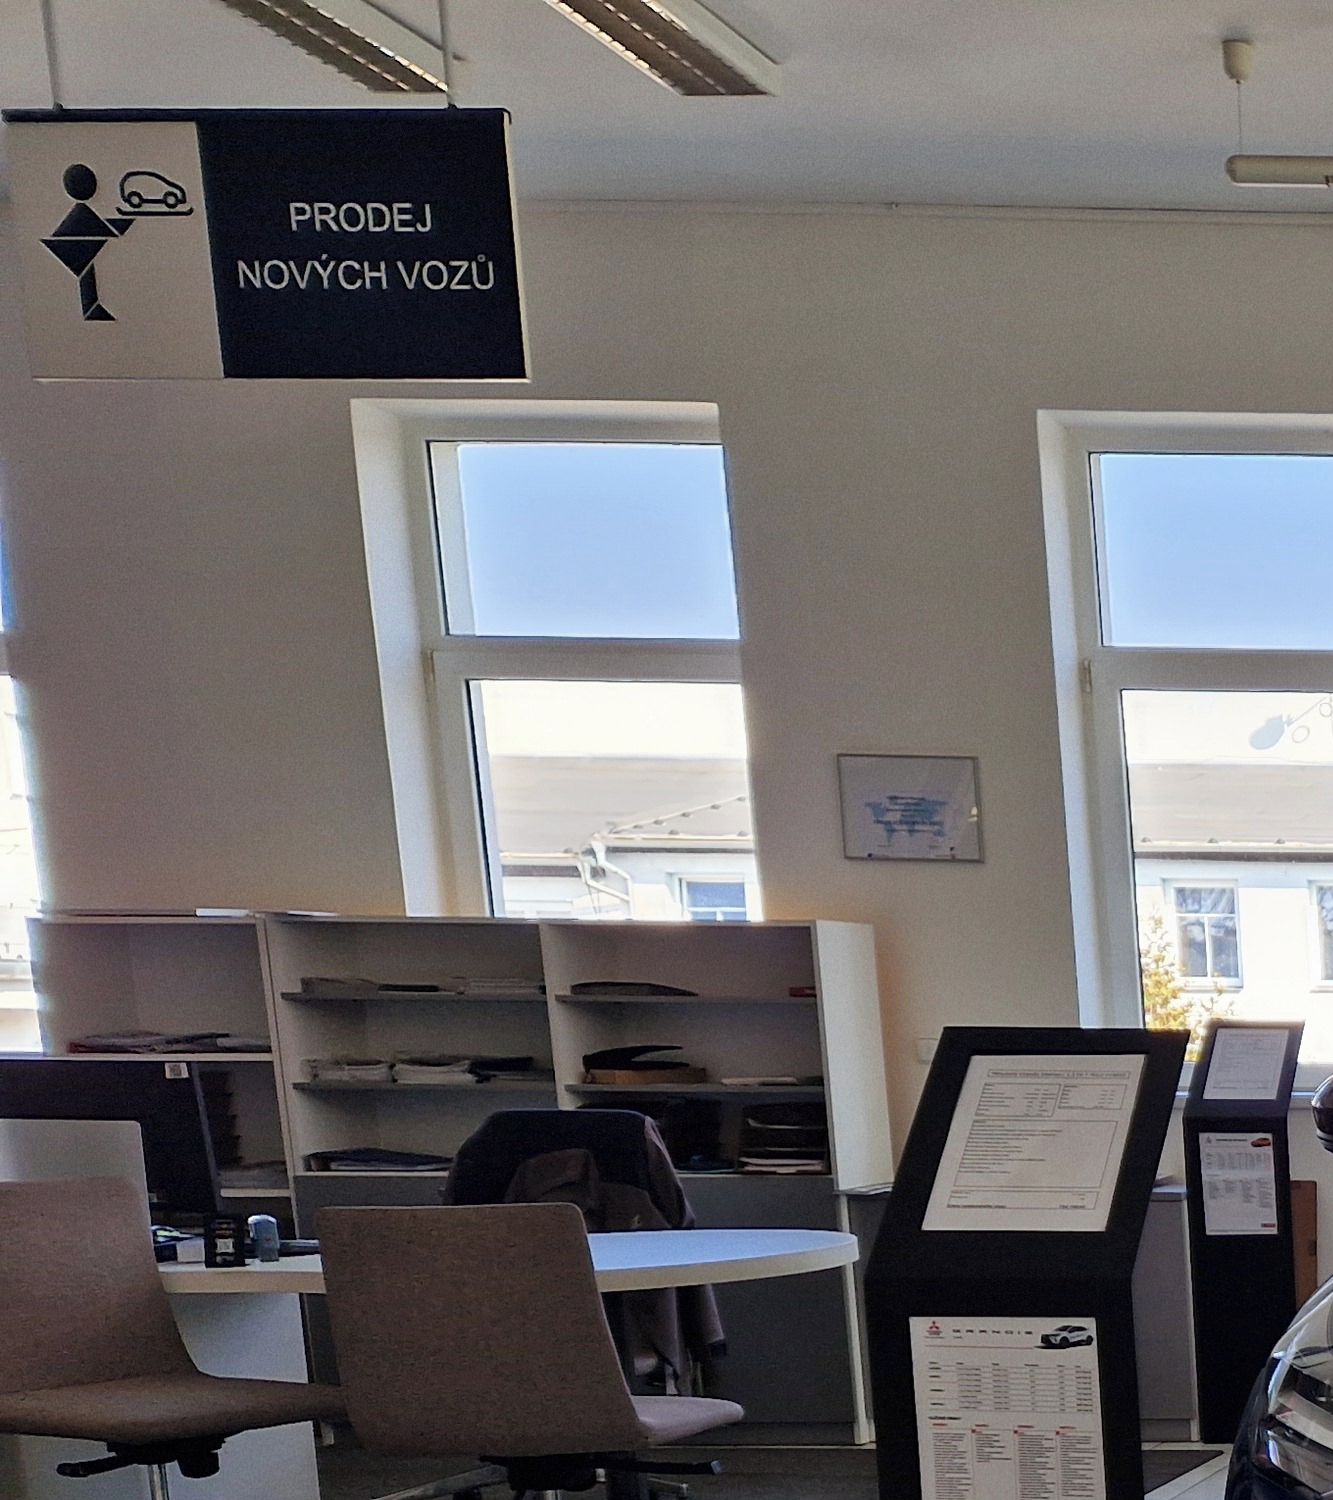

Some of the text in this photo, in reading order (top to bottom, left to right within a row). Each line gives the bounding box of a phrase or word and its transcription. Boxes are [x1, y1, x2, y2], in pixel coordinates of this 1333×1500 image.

[289, 202, 432, 232] PRODEJ
[237, 253, 495, 290] NOVÝCH VOZŮ
